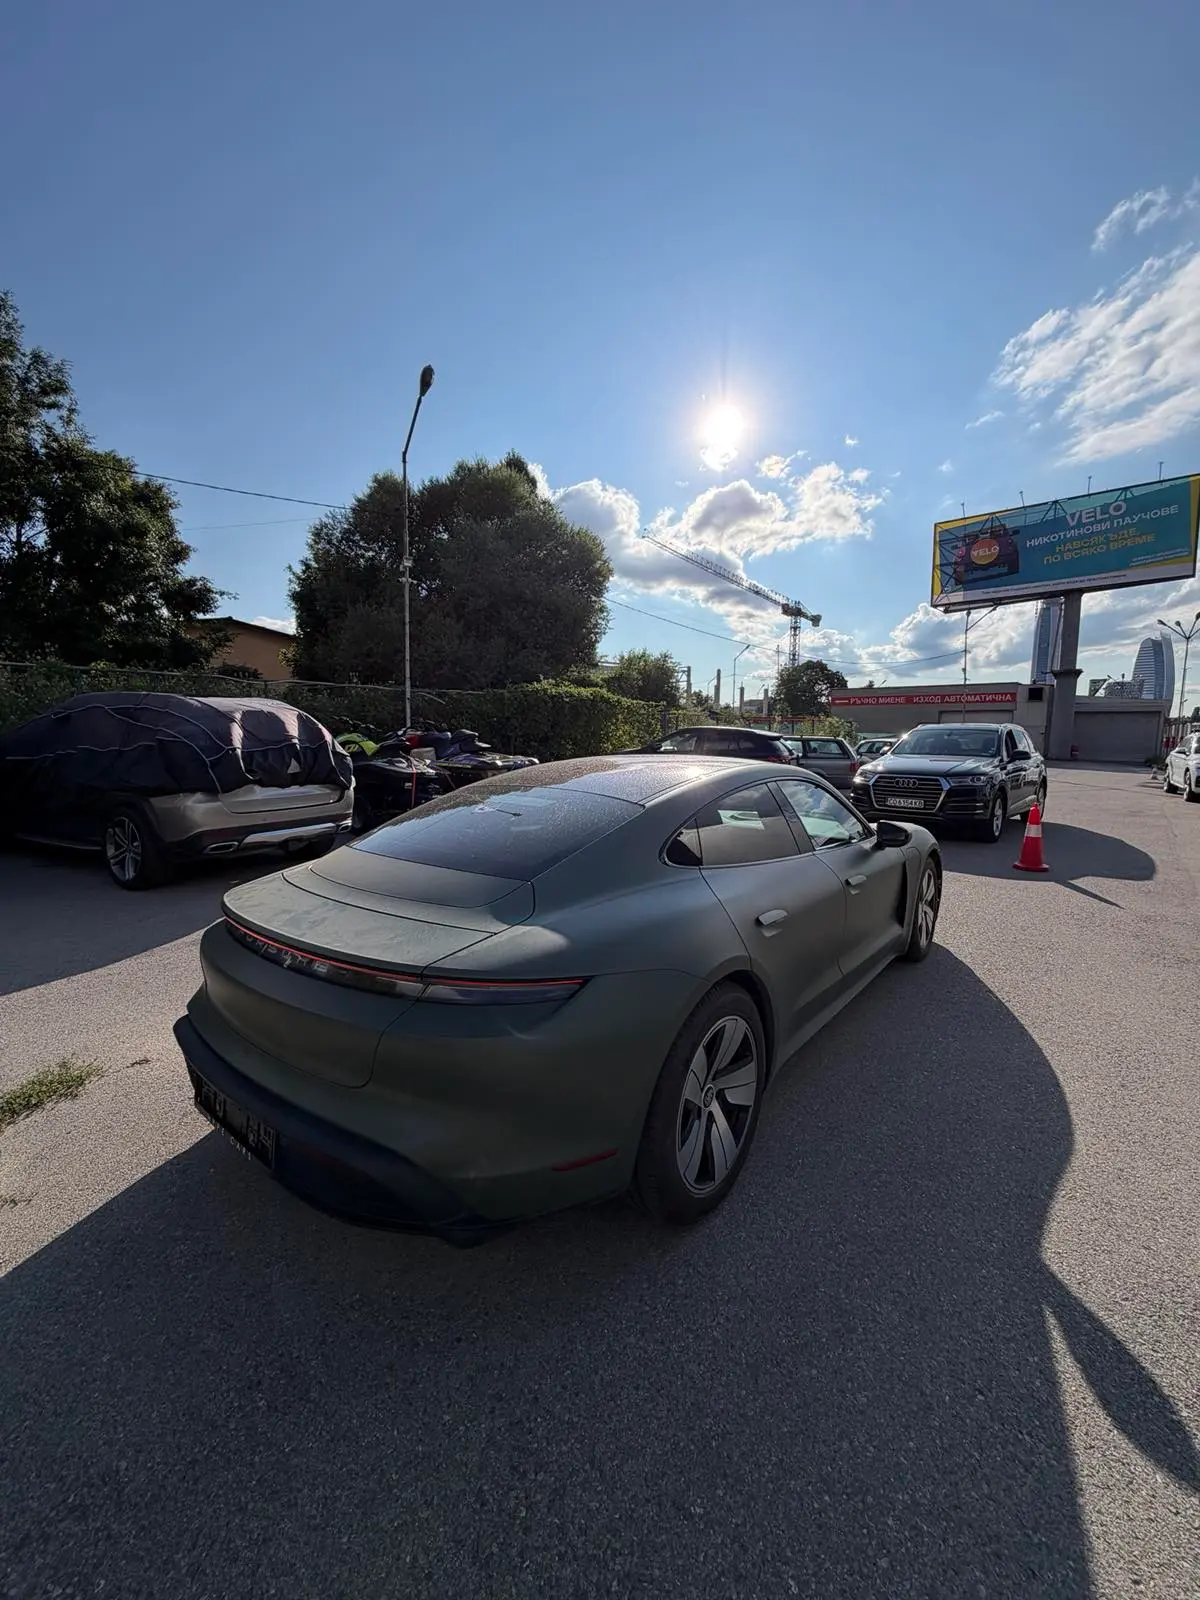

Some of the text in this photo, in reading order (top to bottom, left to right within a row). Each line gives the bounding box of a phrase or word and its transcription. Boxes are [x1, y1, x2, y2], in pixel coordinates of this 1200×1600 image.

[1066, 501, 1127, 527] VELO
[1026, 504, 1179, 549] НИКОТИНОВИ ПАУЧОВЕ
[971, 545, 1000, 557] VELO
[1043, 553, 1061, 565] ПО
[1063, 544, 1107, 561] ВСЯКО
[850, 693, 1012, 705] РЪЧНО МИЕНЕ ИЗХОД АВТОМАТИЧНА
